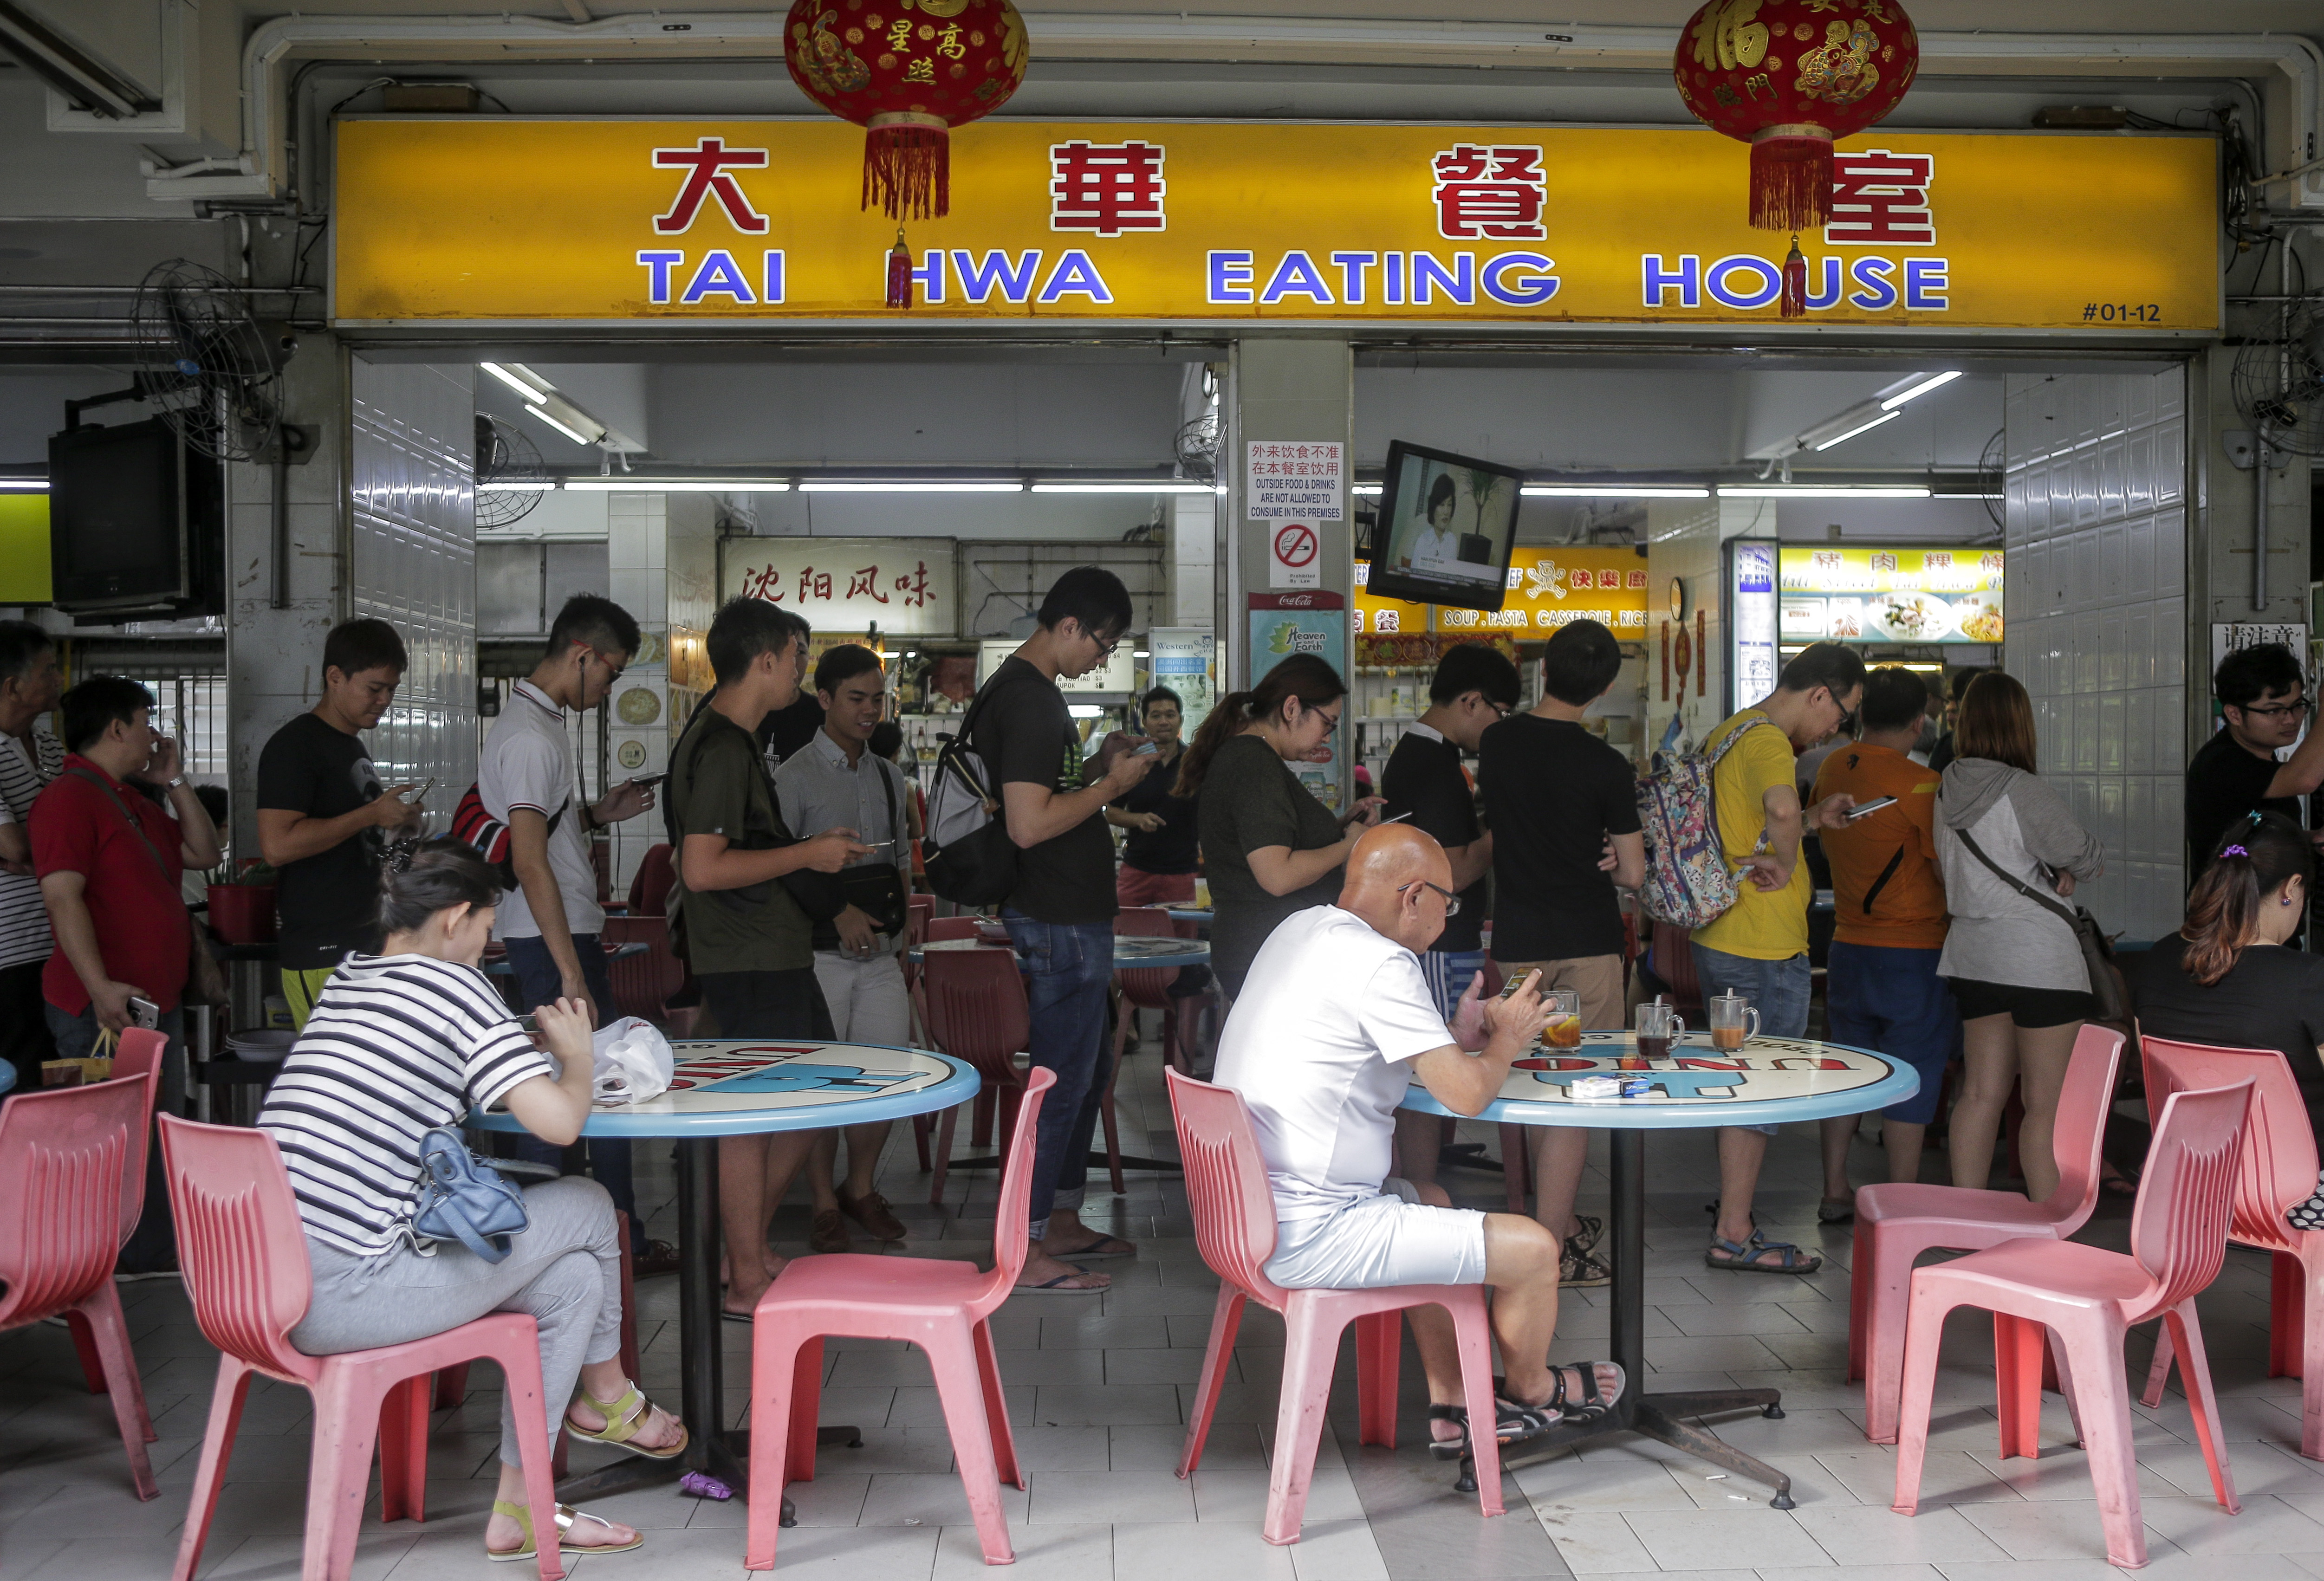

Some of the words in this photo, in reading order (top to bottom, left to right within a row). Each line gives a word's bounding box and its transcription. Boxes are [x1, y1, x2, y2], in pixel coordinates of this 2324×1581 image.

[636, 249, 785, 304] TAI
[885, 249, 1114, 304] HWA
[1207, 249, 1561, 306] EATING
[1641, 254, 1949, 311] HOUSE
[2083, 303, 2162, 322] #01-12
[1253, 444, 1339, 459] 外来饮食不准
[1253, 461, 1338, 476] 在本餐室饮用
[1256, 479, 1284, 488] OUTSIDE
[1285, 479, 1303, 489] FOOD
[1305, 479, 1309, 489] &
[1311, 479, 1335, 489] DRINKS
[1261, 493, 1274, 503] ARE
[1276, 493, 1288, 503] NOT
[1290, 493, 1321, 503] ALLOWED
[1322, 494, 1331, 503] TO
[1251, 507, 1283, 517] CONSUME
[1285, 507, 1291, 517] IN
[1292, 507, 1306, 517] THIS
[1308, 508, 1340, 518] PREMISES
[743, 560, 937, 607] 沈阳风味
[1279, 595, 1313, 606] Coca-Cola
[1444, 610, 1480, 627] SOUP
[1488, 610, 1529, 627] PASTA
[1286, 627, 1326, 644] Heaven
[1294, 641, 1323, 652] Earth
